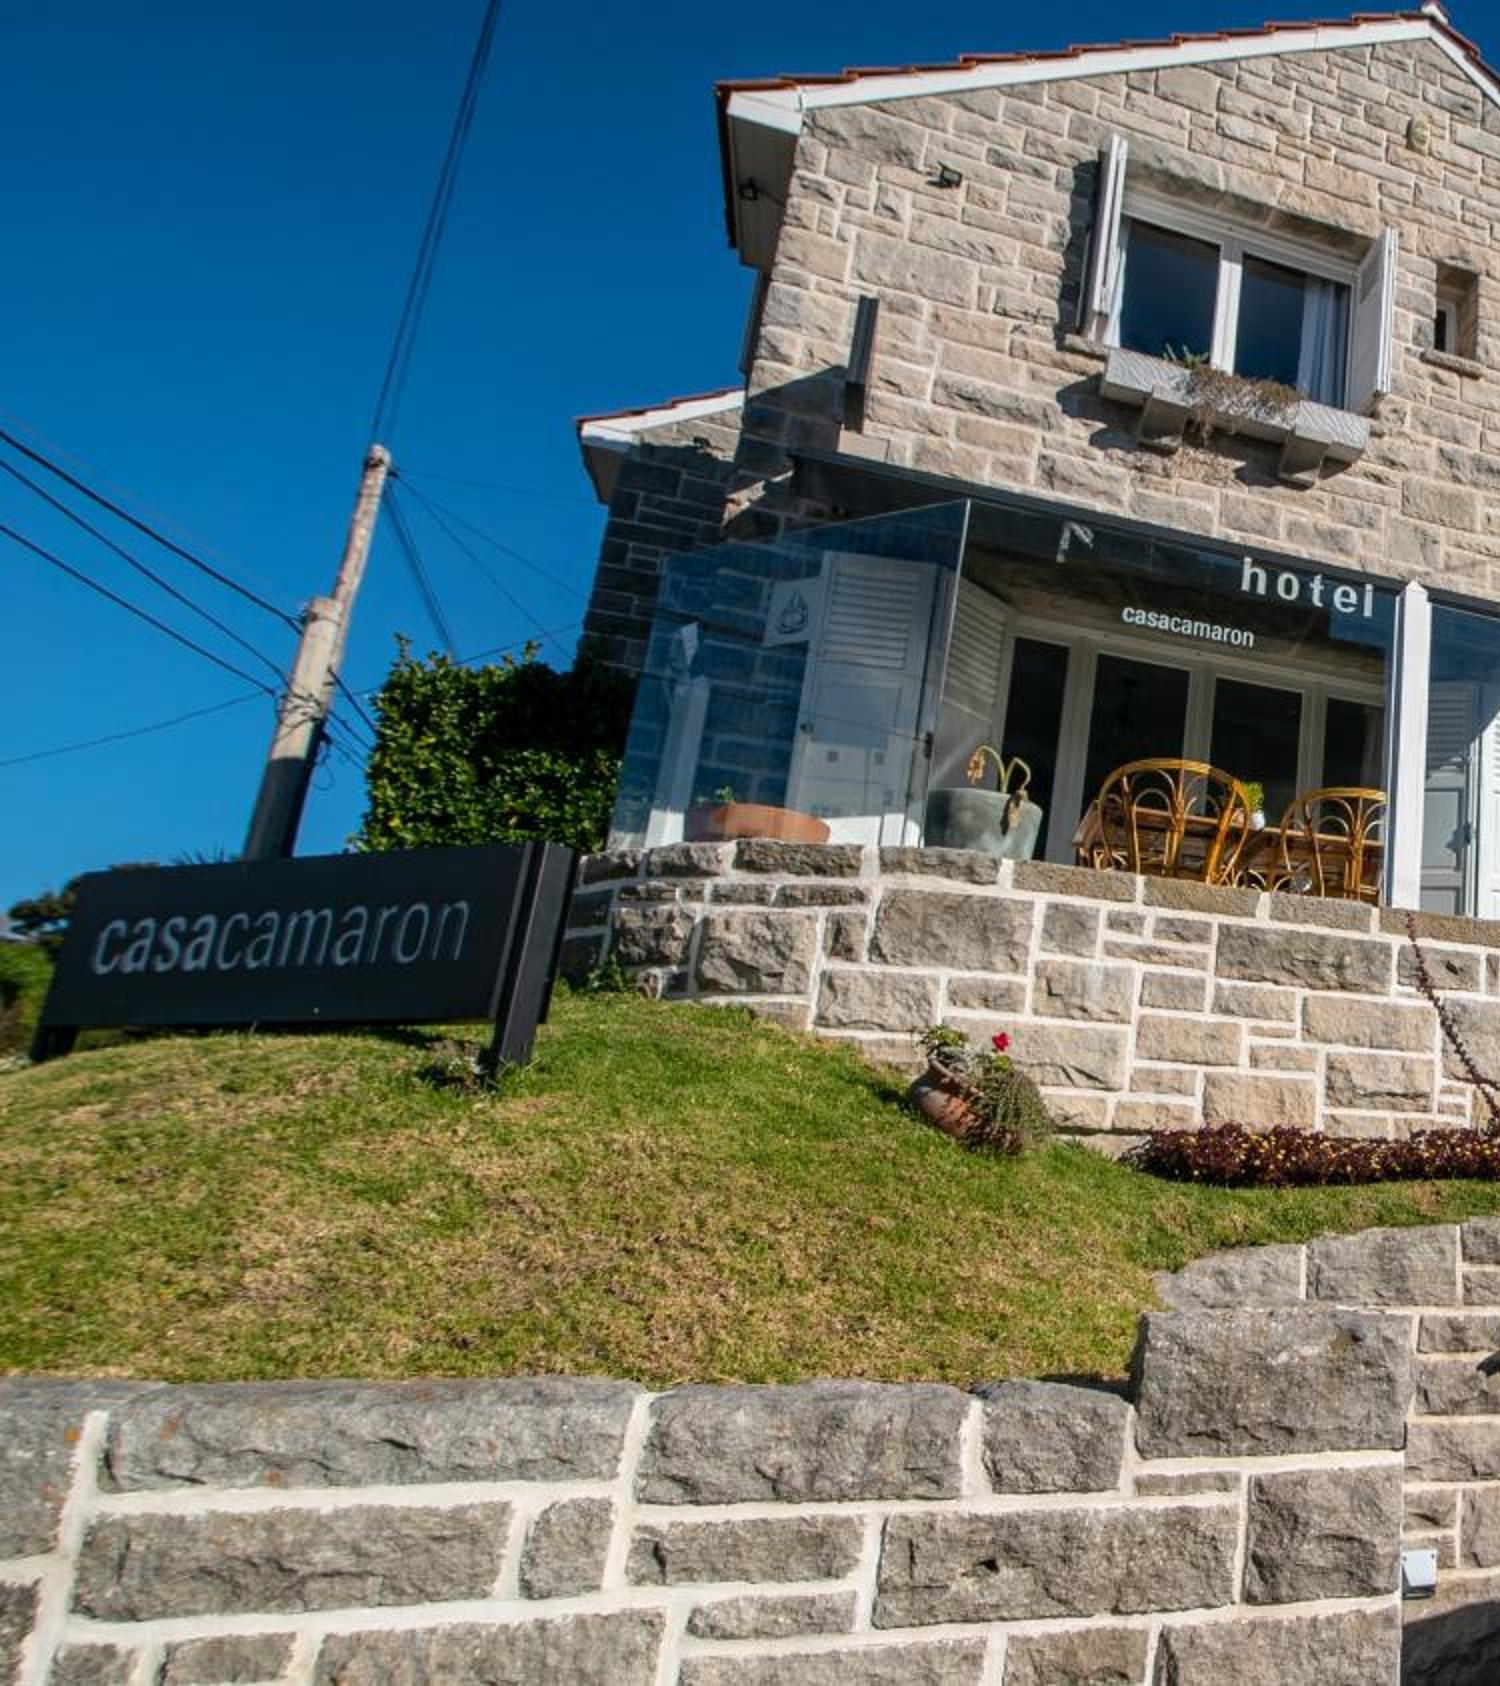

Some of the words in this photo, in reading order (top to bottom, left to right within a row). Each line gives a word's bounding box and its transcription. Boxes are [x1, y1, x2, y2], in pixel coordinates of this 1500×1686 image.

[1241, 557, 1374, 617] hotel
[1122, 606, 1255, 648] casacamaron
[92, 900, 469, 974] casacamaron
